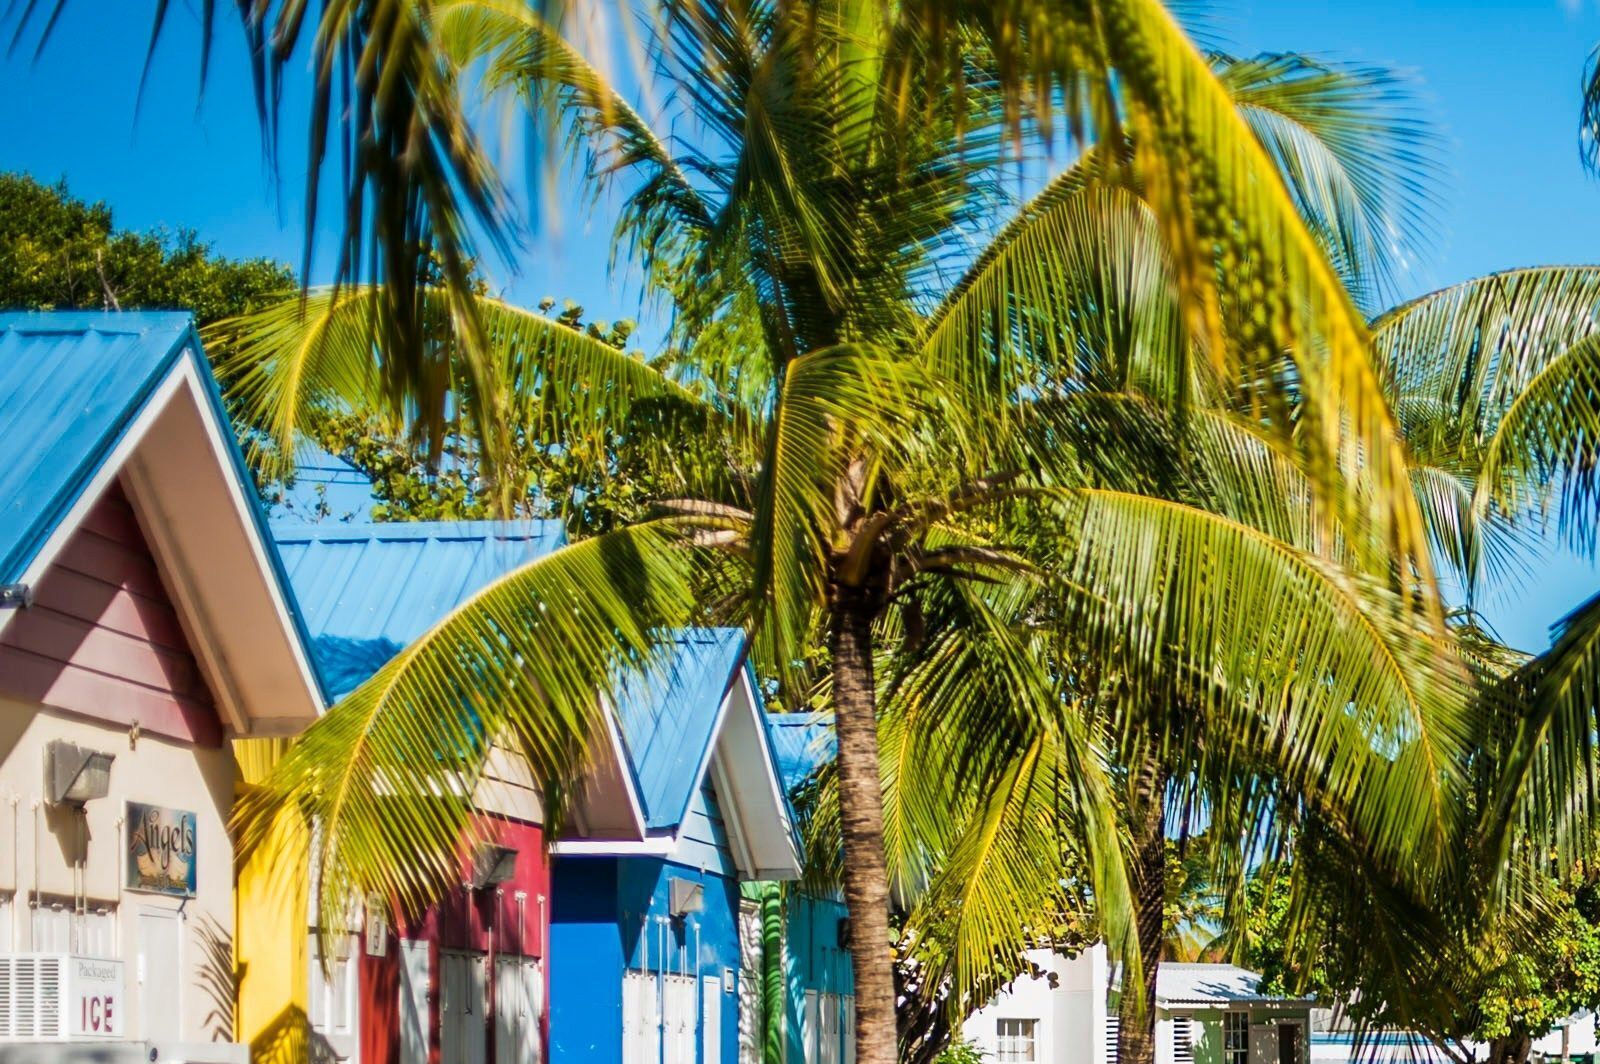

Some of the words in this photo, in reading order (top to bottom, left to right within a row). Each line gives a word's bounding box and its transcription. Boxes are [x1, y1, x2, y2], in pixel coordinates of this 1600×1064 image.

[130, 809, 193, 869] Angels
[79, 961, 117, 982] Packaged
[82, 995, 113, 1032] ICE
